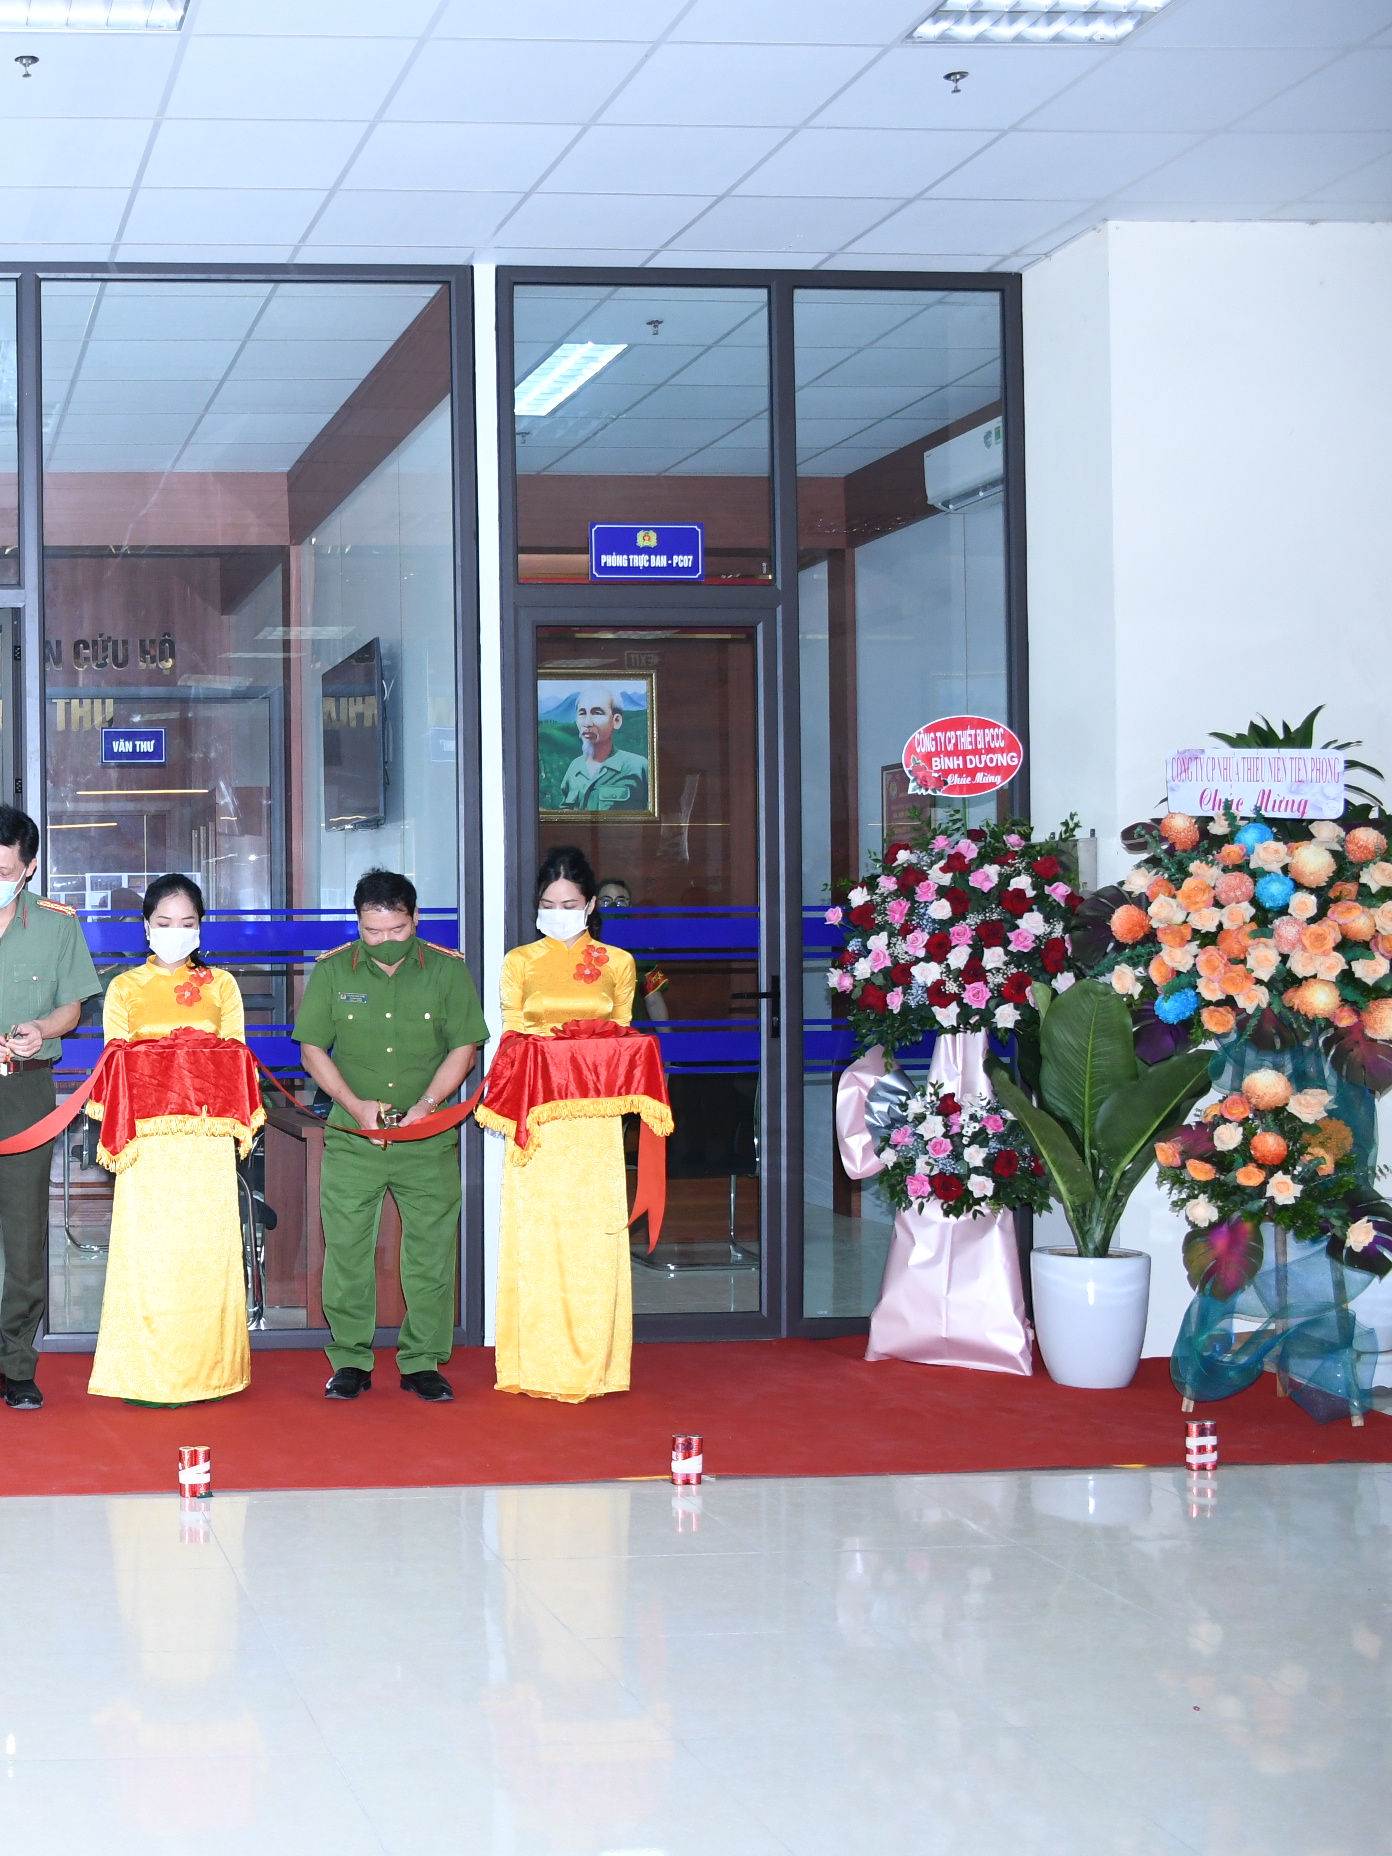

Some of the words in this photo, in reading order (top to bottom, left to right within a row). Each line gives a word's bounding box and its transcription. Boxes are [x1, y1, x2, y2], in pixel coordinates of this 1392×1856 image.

[601, 552, 628, 567] PHÒNG
[629, 554, 649, 570] TRỰC
[650, 555, 667, 567] BAN
[673, 555, 694, 568] PC07
[73, 633, 129, 670] CỨU
[138, 632, 176, 675] HỘ
[112, 738, 133, 752] VĂN
[134, 739, 155, 752] THƯ
[915, 729, 936, 753] CÔNG
[936, 731, 946, 752] TY
[946, 731, 956, 751] CP
[956, 725, 977, 750] THIẾT
[985, 728, 1005, 748] PCCC
[931, 754, 963, 770] BÌNH
[966, 752, 1019, 768] DƯƠNG
[1194, 757, 1205, 782] TY
[948, 773, 972, 785] Chúc
[972, 772, 1002, 785] Mừng
